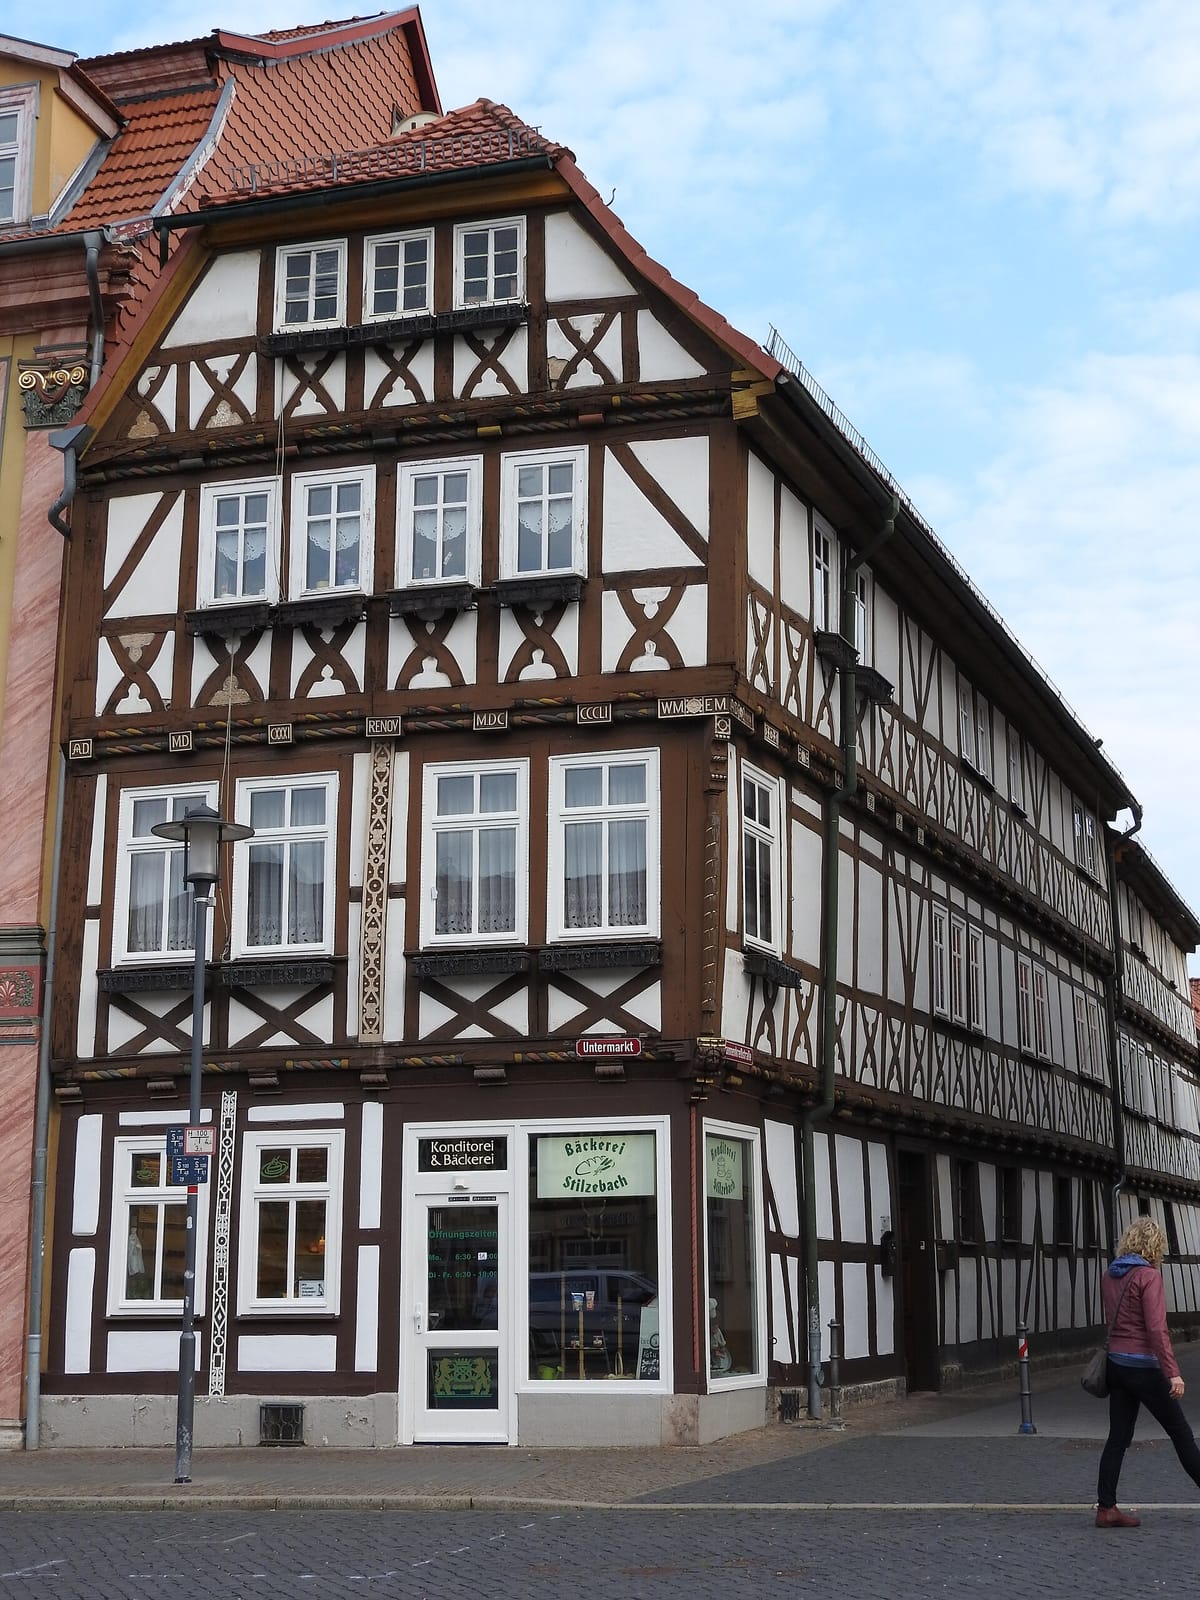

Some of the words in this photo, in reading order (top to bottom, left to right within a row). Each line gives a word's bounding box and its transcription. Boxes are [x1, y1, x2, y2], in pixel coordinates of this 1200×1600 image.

[72, 742, 89, 755] AD
[172, 734, 190, 748] MD
[368, 719, 399, 733] RENOV
[582, 1041, 634, 1053] Untermarkt
[431, 1140, 494, 1153] Konditorei
[564, 1138, 626, 1156] Bäckerei
[430, 1154, 442, 1166] &
[443, 1153, 494, 1166] Bäckerei
[563, 1174, 628, 1193] Stilzebach
